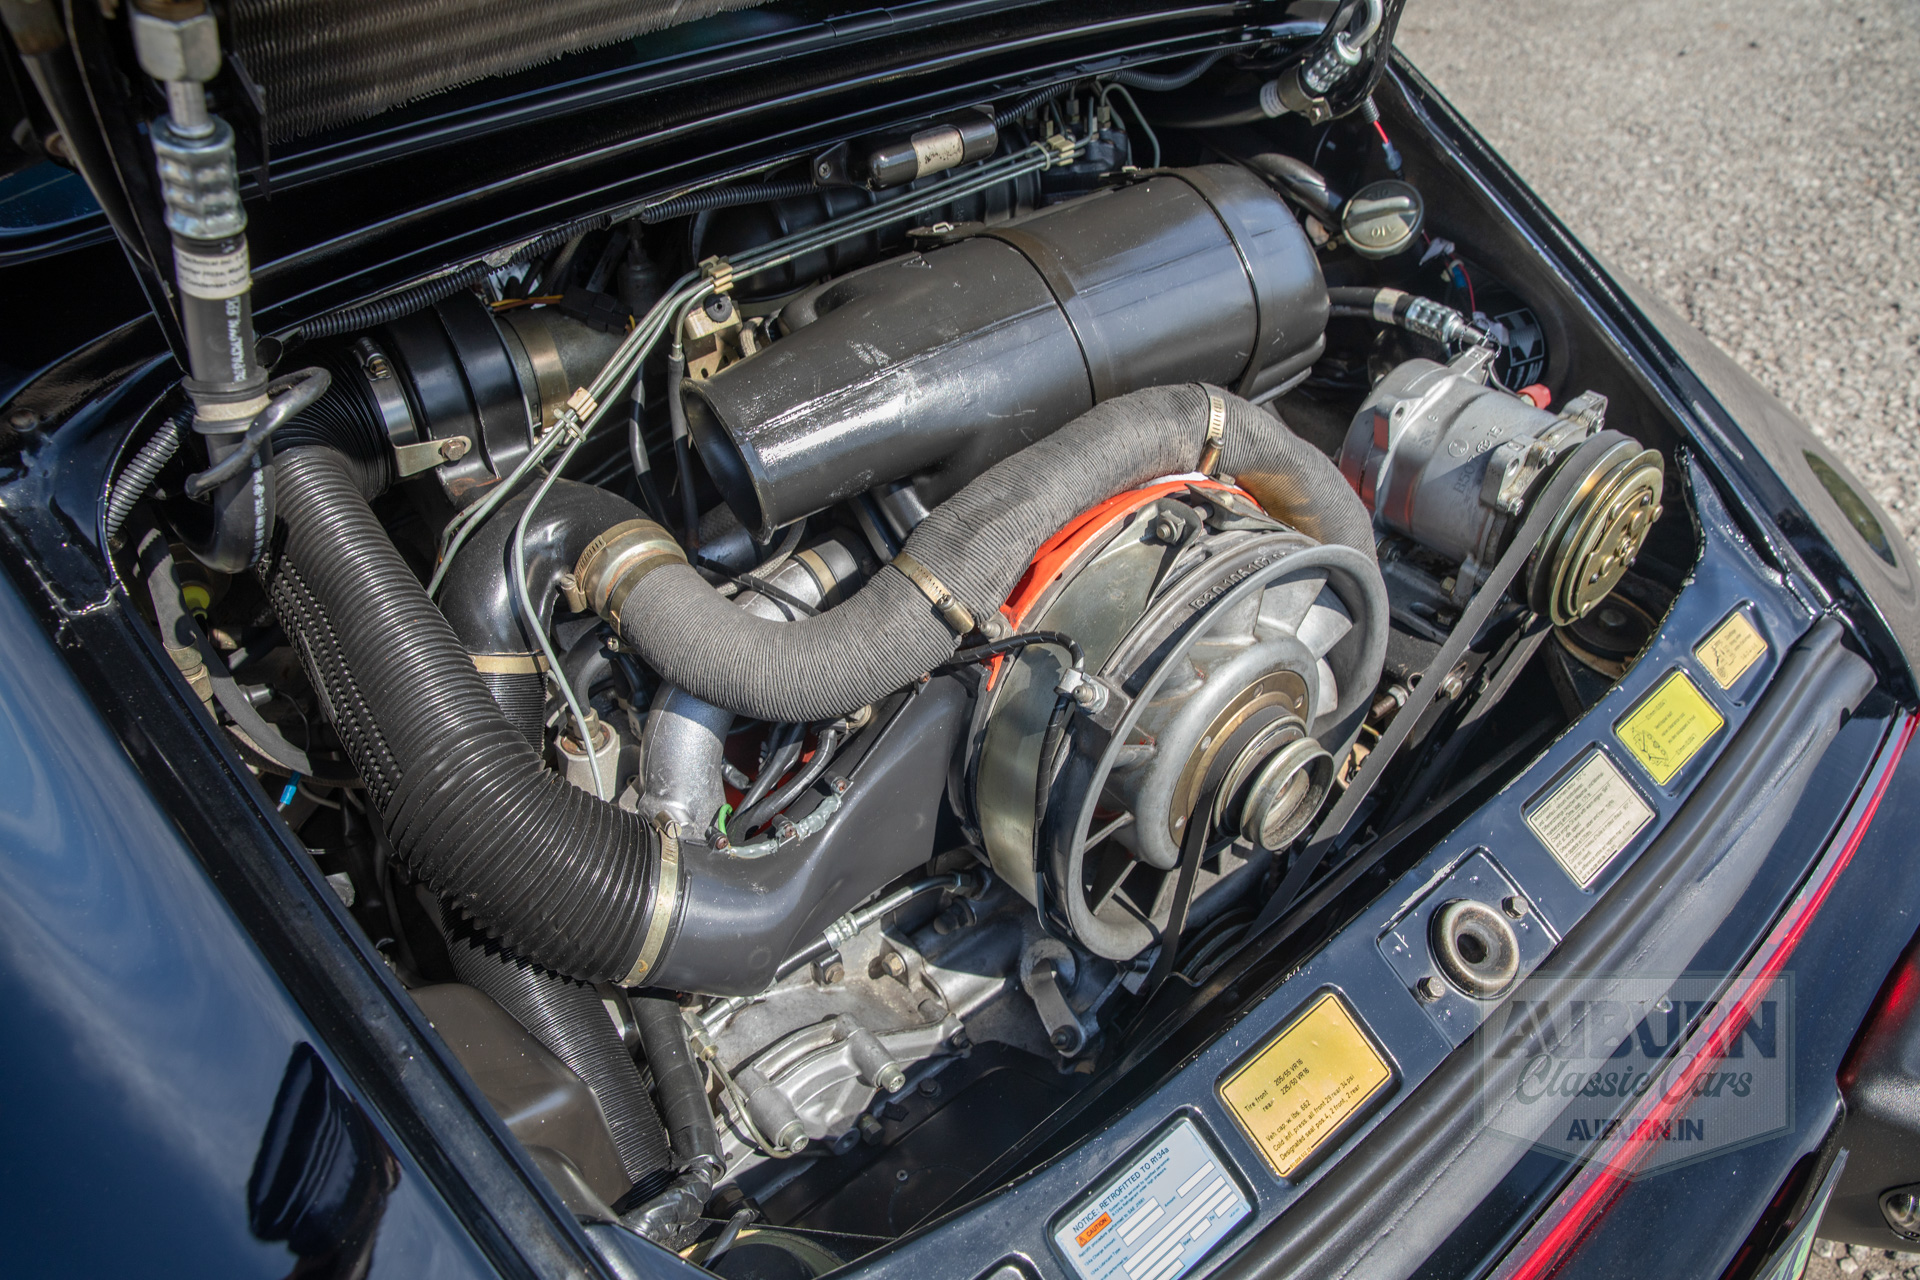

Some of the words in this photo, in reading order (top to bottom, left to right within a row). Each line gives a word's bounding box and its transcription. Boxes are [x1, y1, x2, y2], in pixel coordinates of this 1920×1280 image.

[1371, 219, 1398, 237] OIL
[1273, 1069, 1291, 1086] 205/55
[1290, 1063, 1298, 1071] VR
[1280, 1077, 1298, 1095] 225/50
[1296, 1071, 1305, 1080] VR
[1244, 1102, 1255, 1111] Tire
[1255, 1089, 1268, 1103] front
[1300, 1099, 1311, 1111] 662
[1273, 1139, 1285, 1151] Cold
[1313, 1100, 1326, 1113] front
[1331, 1086, 1341, 1098] rear
[1346, 1075, 1354, 1084] psi
[1279, 1135, 1305, 1160] Designated
[1305, 1125, 1315, 1137] seat
[1350, 1084, 1359, 1095] rear
[1072, 1209, 1100, 1233] NOTICE:
[1099, 1171, 1140, 1210] RETROFITTED
[1140, 1162, 1151, 1173] TO
[1150, 1147, 1169, 1165] R134a
[1086, 1217, 1108, 1237] CAUTION:
[1108, 1216, 1124, 1233] performed
